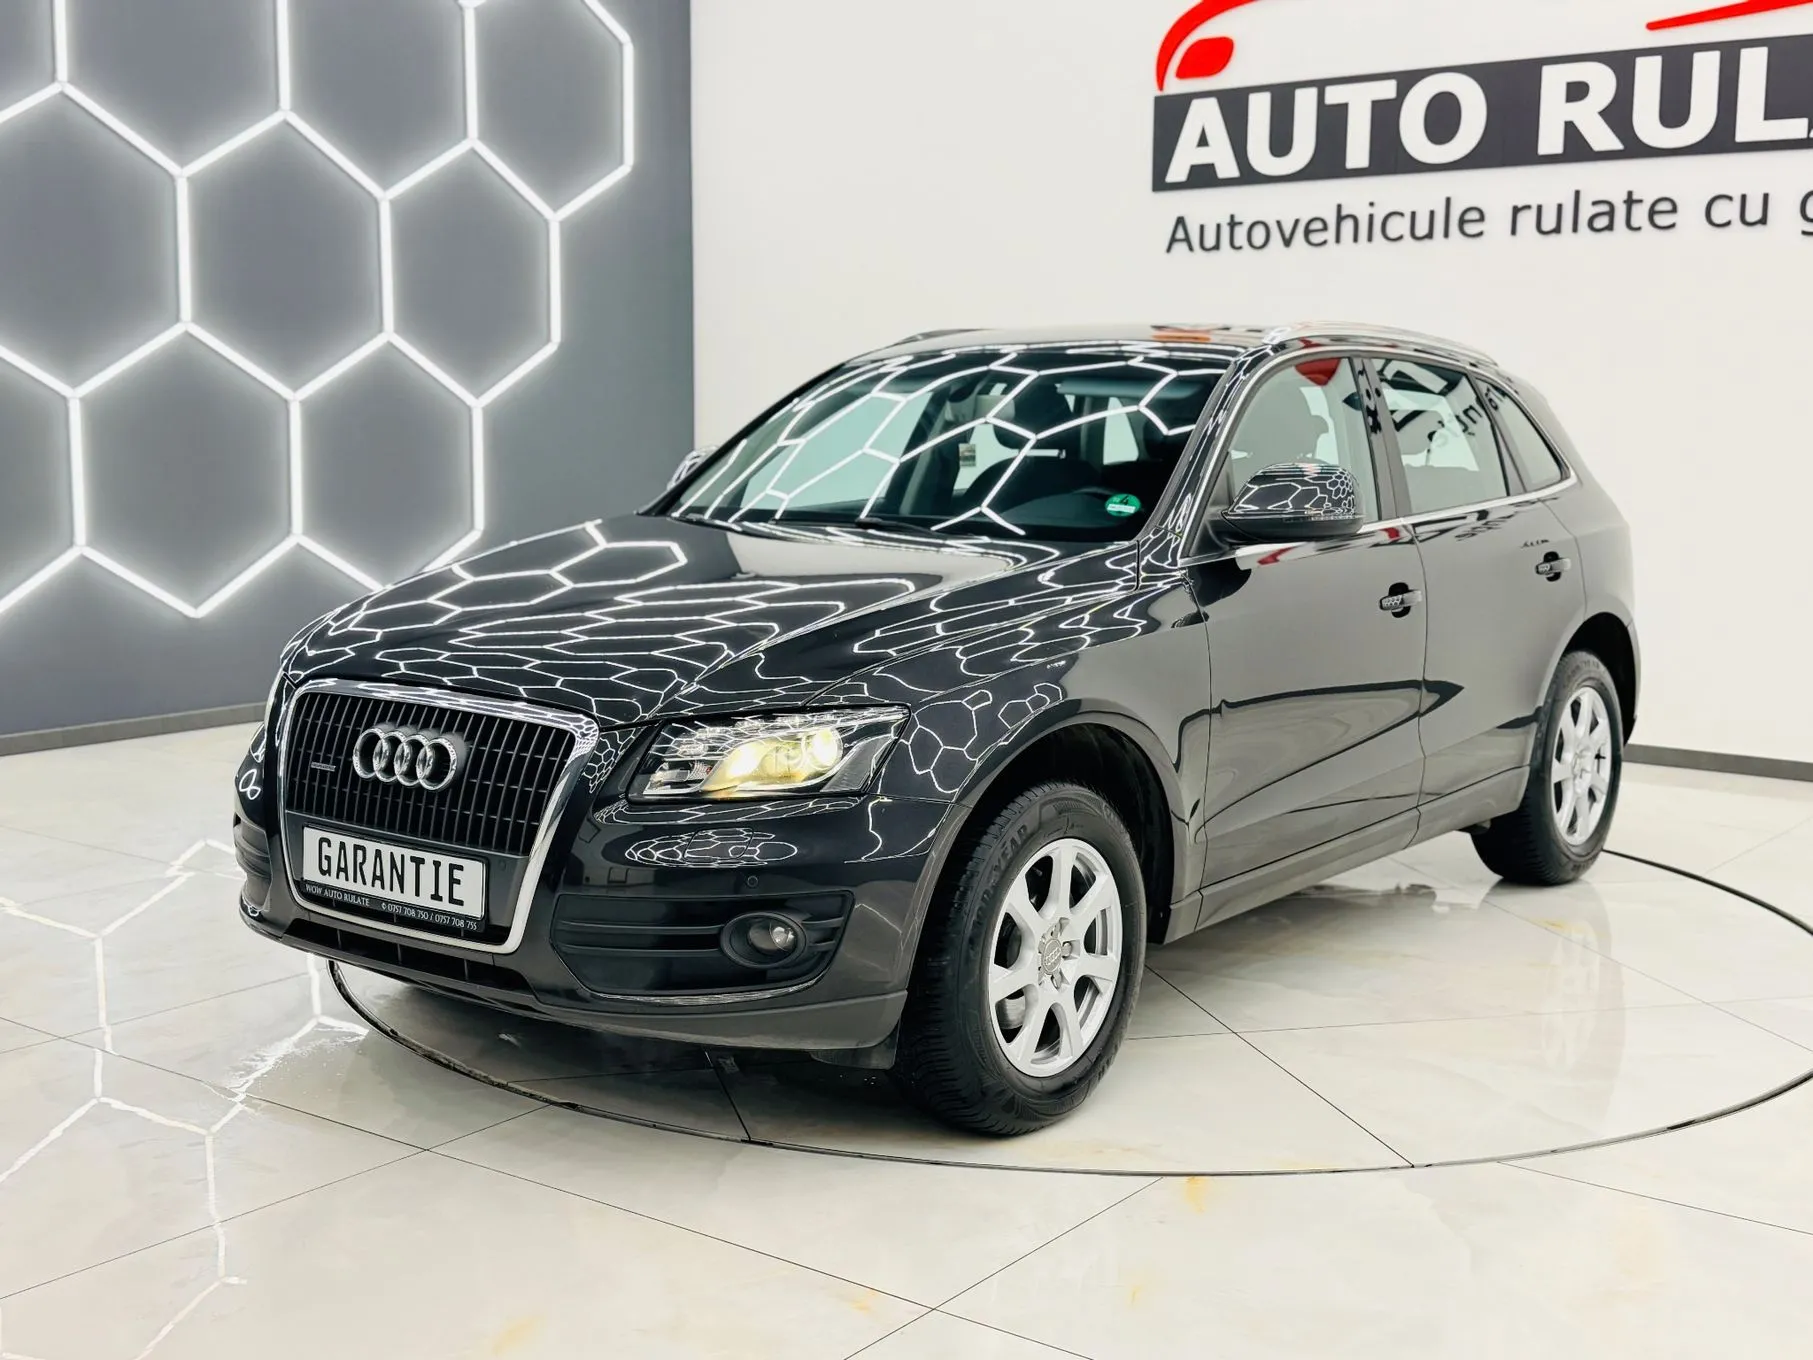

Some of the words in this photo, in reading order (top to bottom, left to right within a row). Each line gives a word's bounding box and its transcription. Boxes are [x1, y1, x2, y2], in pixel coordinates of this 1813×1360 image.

[1165, 72, 1487, 183] AUTO
[1537, 46, 1813, 156] RUL
[1166, 196, 1485, 254] Autovehicule
[1511, 190, 1678, 236] rulate
[1704, 192, 1769, 228] cu
[318, 837, 464, 907] GARANTIE
[305, 883, 322, 895] WOW
[323, 888, 343, 900] AUTO
[343, 893, 370, 907] RULATE
[387, 903, 402, 914] 0757
[403, 906, 416, 917] 708
[417, 909, 429, 920] 750
[434, 913, 450, 925] 0757
[451, 917, 465, 928] 708
[466, 920, 478, 931] 755
